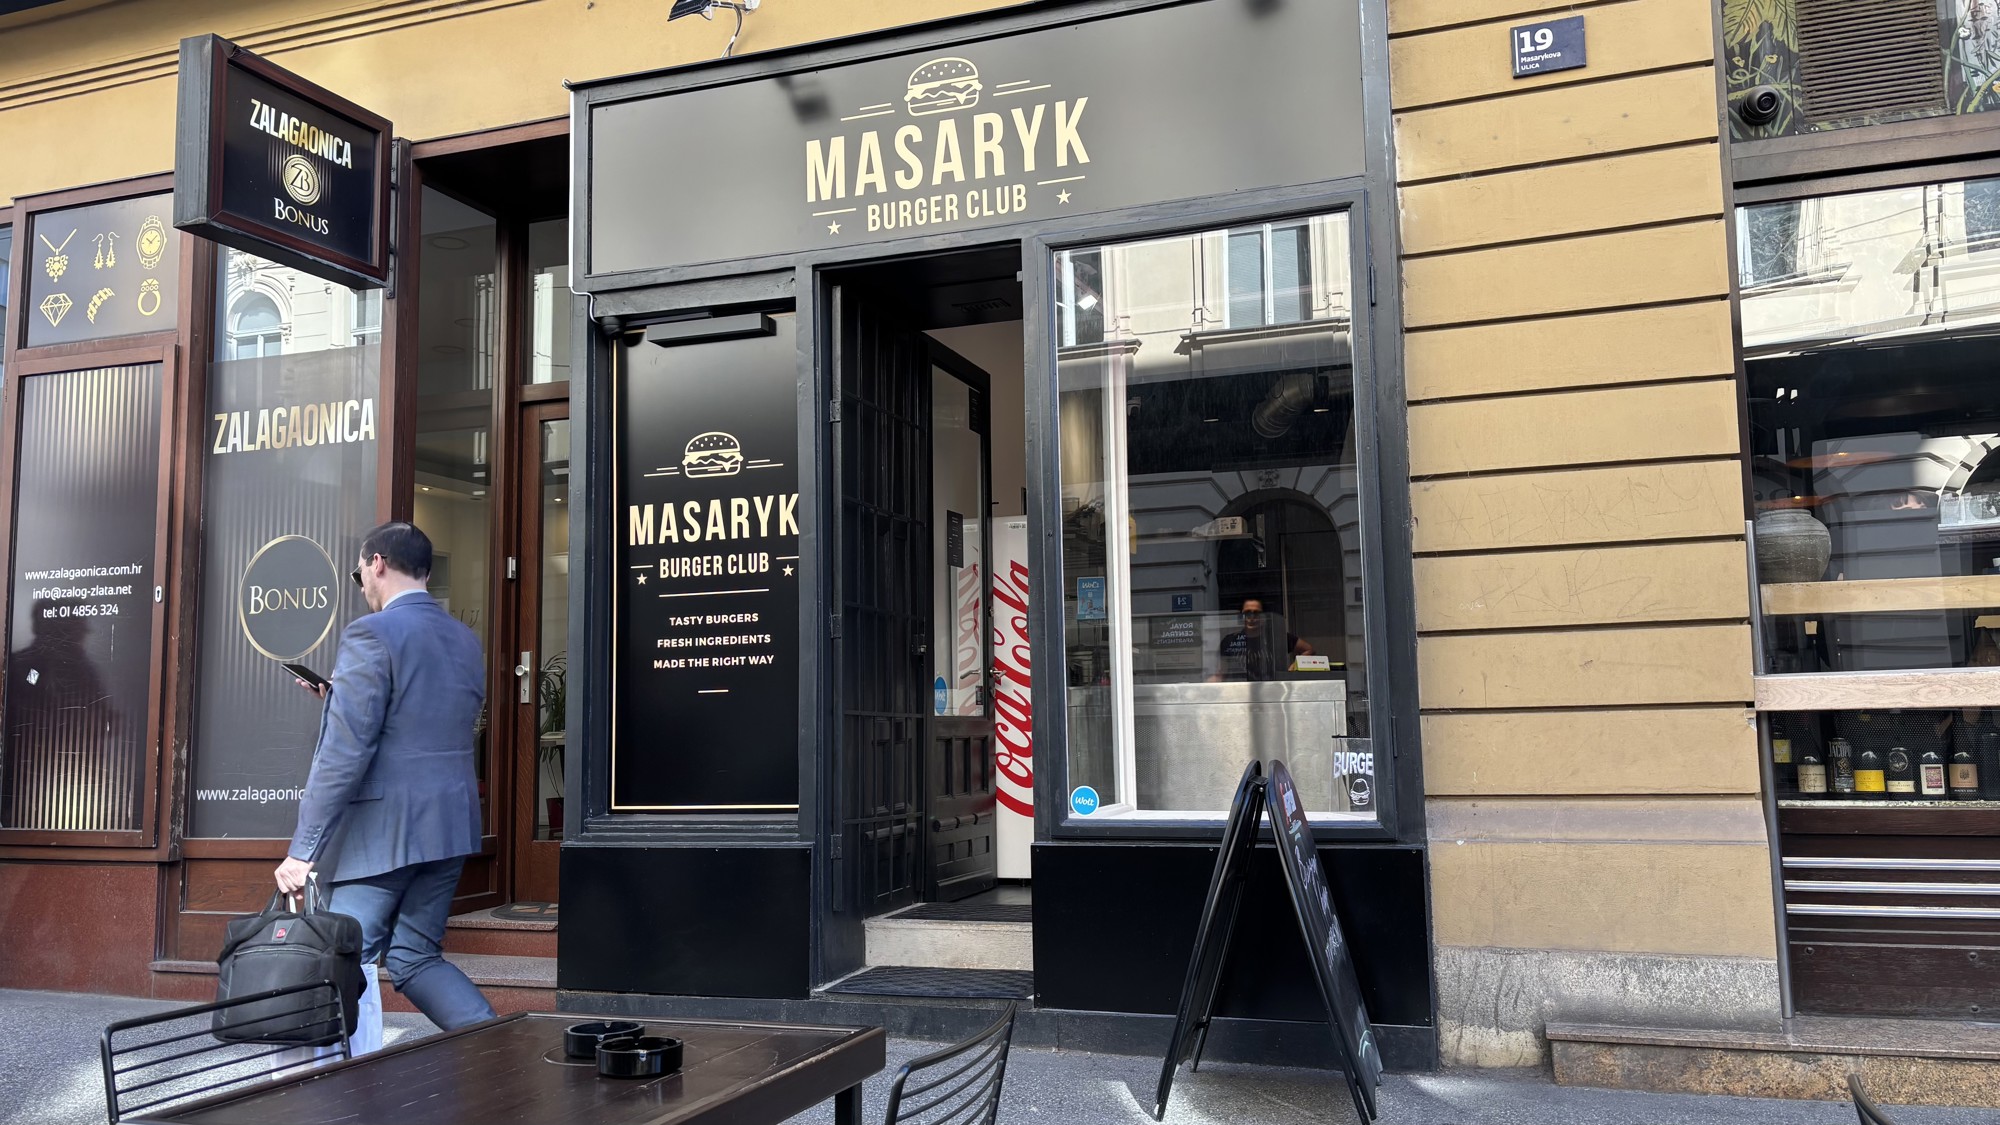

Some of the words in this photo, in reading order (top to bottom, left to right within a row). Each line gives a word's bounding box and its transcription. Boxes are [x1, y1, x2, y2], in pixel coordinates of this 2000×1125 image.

[1519, 28, 1554, 53] 19
[1520, 51, 1561, 63] Masarykova
[1520, 63, 1540, 71] ULICA
[249, 98, 353, 170] ZALAGAONICA
[805, 96, 1091, 203] MASARYK
[867, 193, 959, 232] BURGER
[966, 183, 1028, 219] CLUB
[213, 398, 376, 455] ZALAGAONICA
[629, 493, 800, 546] MASARYK
[25, 563, 143, 581] www.zalagaonica.com.hr
[659, 555, 723, 579] BURGER
[727, 552, 769, 575] CLUB
[32, 584, 133, 601] info@zalog-zlata.net
[43, 605, 58, 618] tel:
[59, 606, 70, 617] 01
[72, 605, 98, 617] 4856
[99, 604, 119, 616] 324
[669, 615, 704, 627] TASTY
[706, 612, 759, 625] BURGERS
[657, 637, 693, 648] FRESH
[695, 634, 772, 647] INGREDIENTS
[653, 658, 685, 669] MADE
[688, 657, 710, 668] THE
[712, 656, 747, 667] RIGHT
[748, 654, 775, 665] WAY
[1333, 751, 1374, 779] BURGE
[1075, 796, 1095, 806] Wolt
